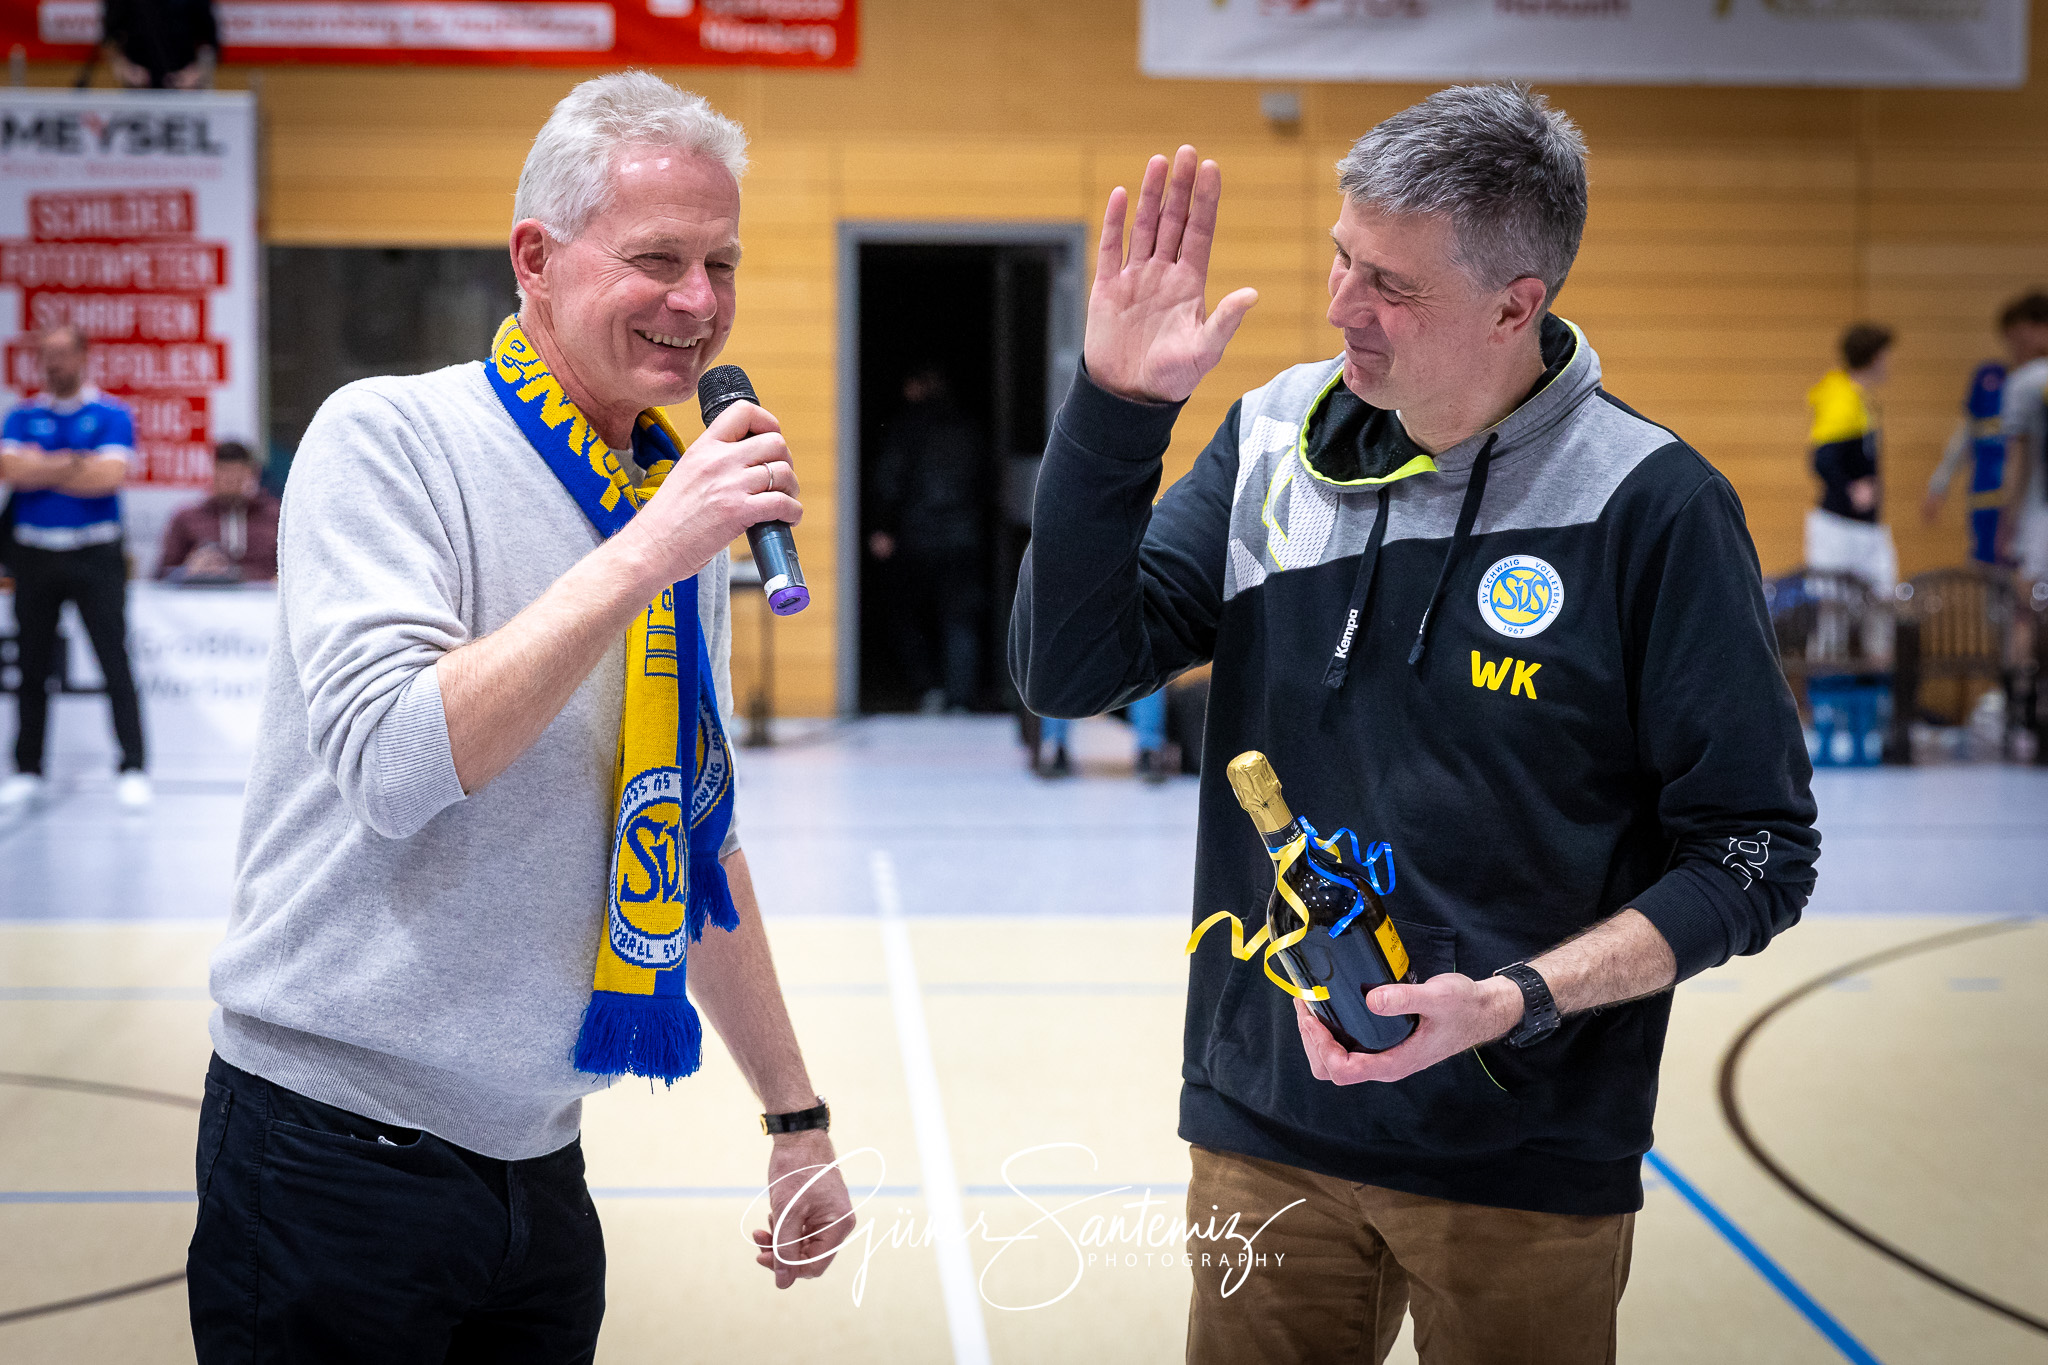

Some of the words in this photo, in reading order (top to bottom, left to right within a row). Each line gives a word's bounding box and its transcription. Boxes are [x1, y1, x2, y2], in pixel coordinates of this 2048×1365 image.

[1, 111, 226, 157] MEYSEL
[1483, 558, 1520, 589] SCHWAIG
[1535, 561, 1560, 614] VOLLEYBALL
[1482, 592, 1489, 604] SV
[1334, 608, 1359, 659] Kempa
[1503, 625, 1525, 634] 1967
[1471, 649, 1542, 700] WK
